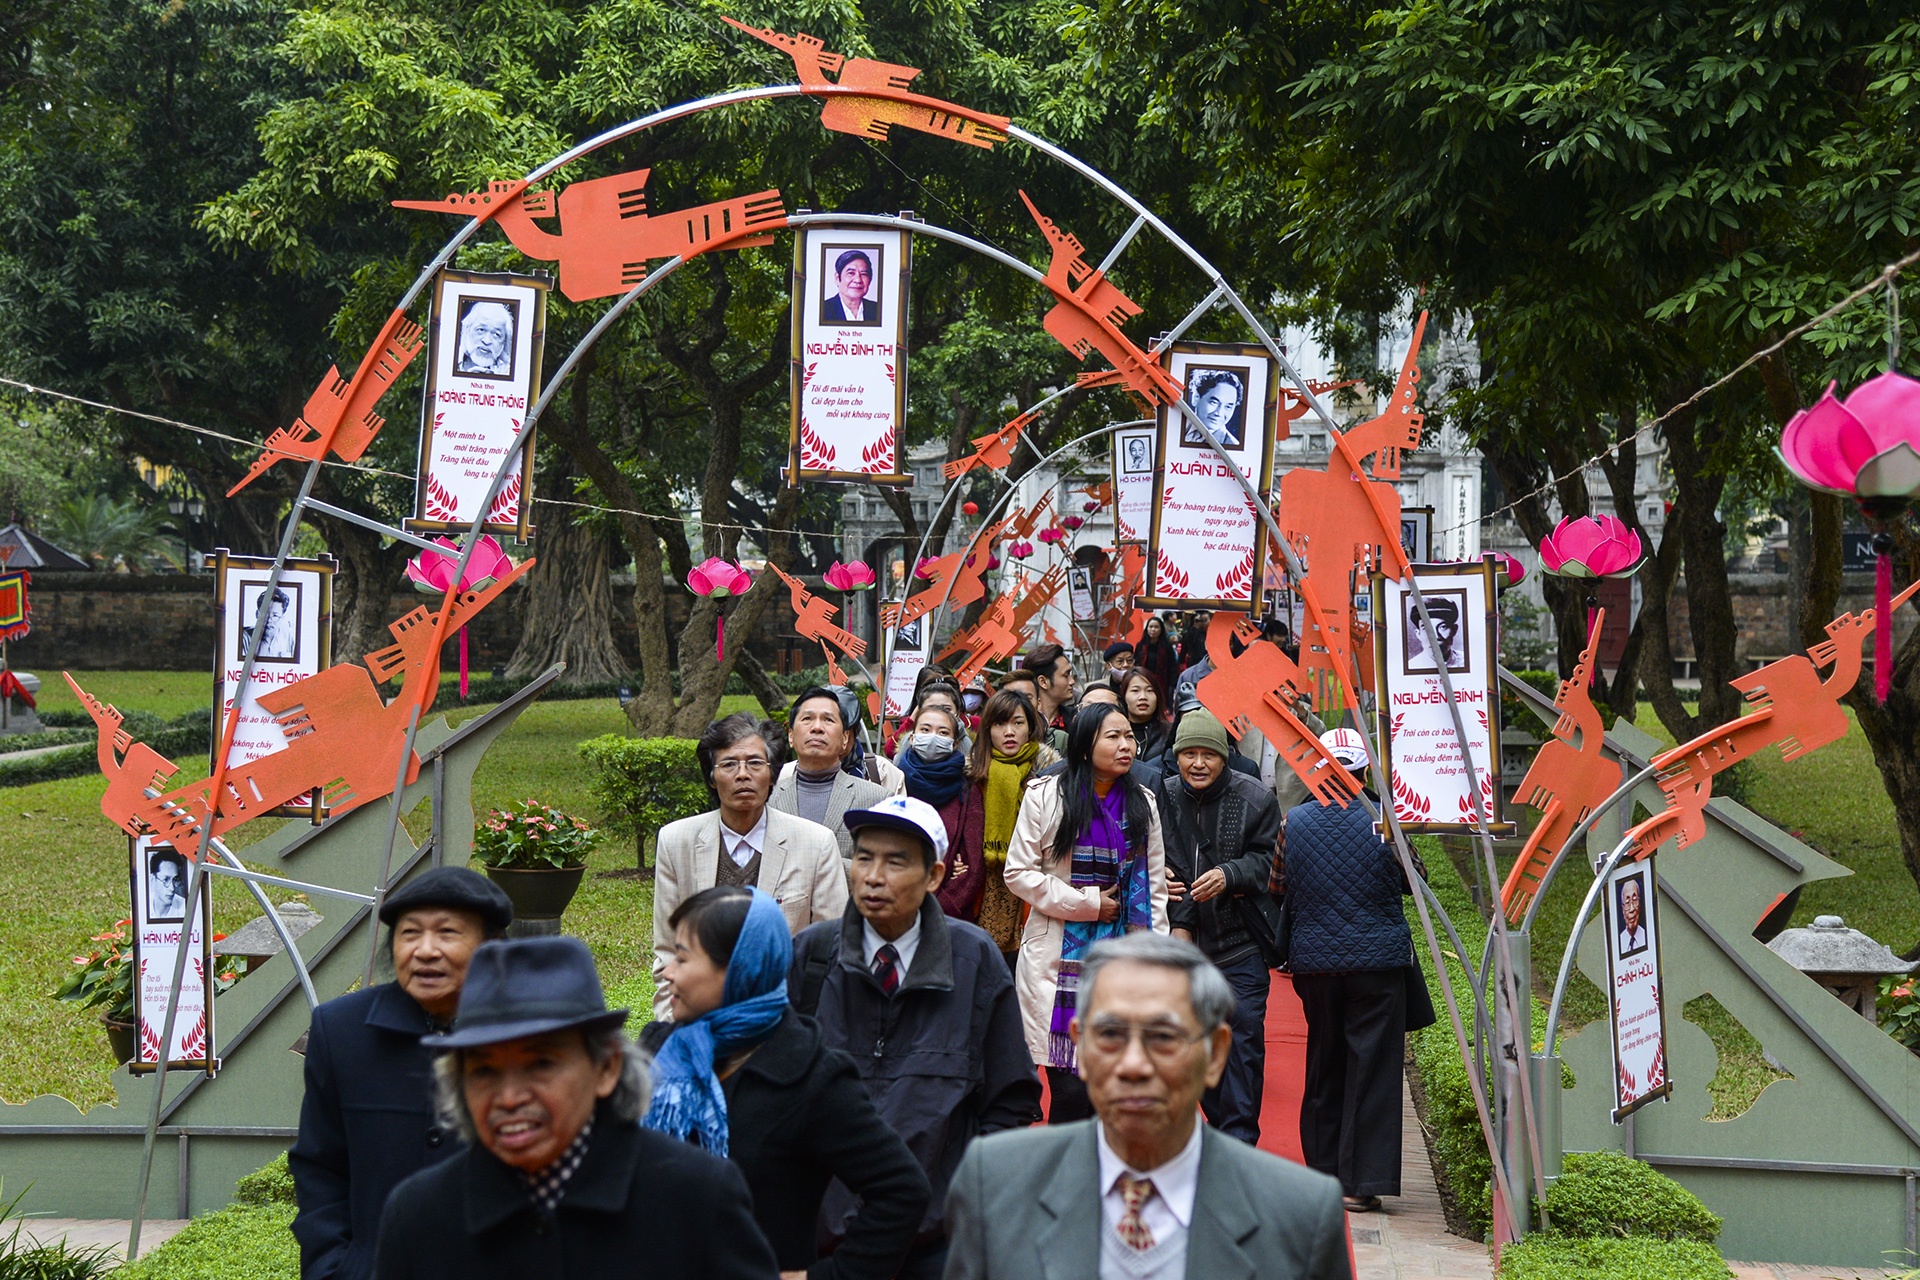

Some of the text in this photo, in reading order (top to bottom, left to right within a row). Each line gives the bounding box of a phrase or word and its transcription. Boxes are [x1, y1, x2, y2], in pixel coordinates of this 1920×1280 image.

[807, 338, 893, 356] NGUYỄN ĐÌNH THI
[822, 385, 829, 393] đi
[438, 389, 524, 409] HOÀNG TRUNG THÔNG
[823, 398, 836, 407] đẹp
[851, 398, 863, 406] cho
[443, 430, 458, 440] Một
[478, 433, 485, 441] ta
[1170, 461, 1212, 476] XUÂN
[1168, 501, 1183, 511] Huy
[1204, 518, 1250, 528] nguy nga gió
[1165, 526, 1184, 535] Xanh
[1204, 542, 1217, 551] bạc
[227, 668, 274, 683] NGYÊN
[1393, 686, 1448, 705] NGUYỄN
[1468, 741, 1484, 749] mọc
[143, 931, 162, 944] HÀN
[1617, 969, 1637, 987] CHÍNH
